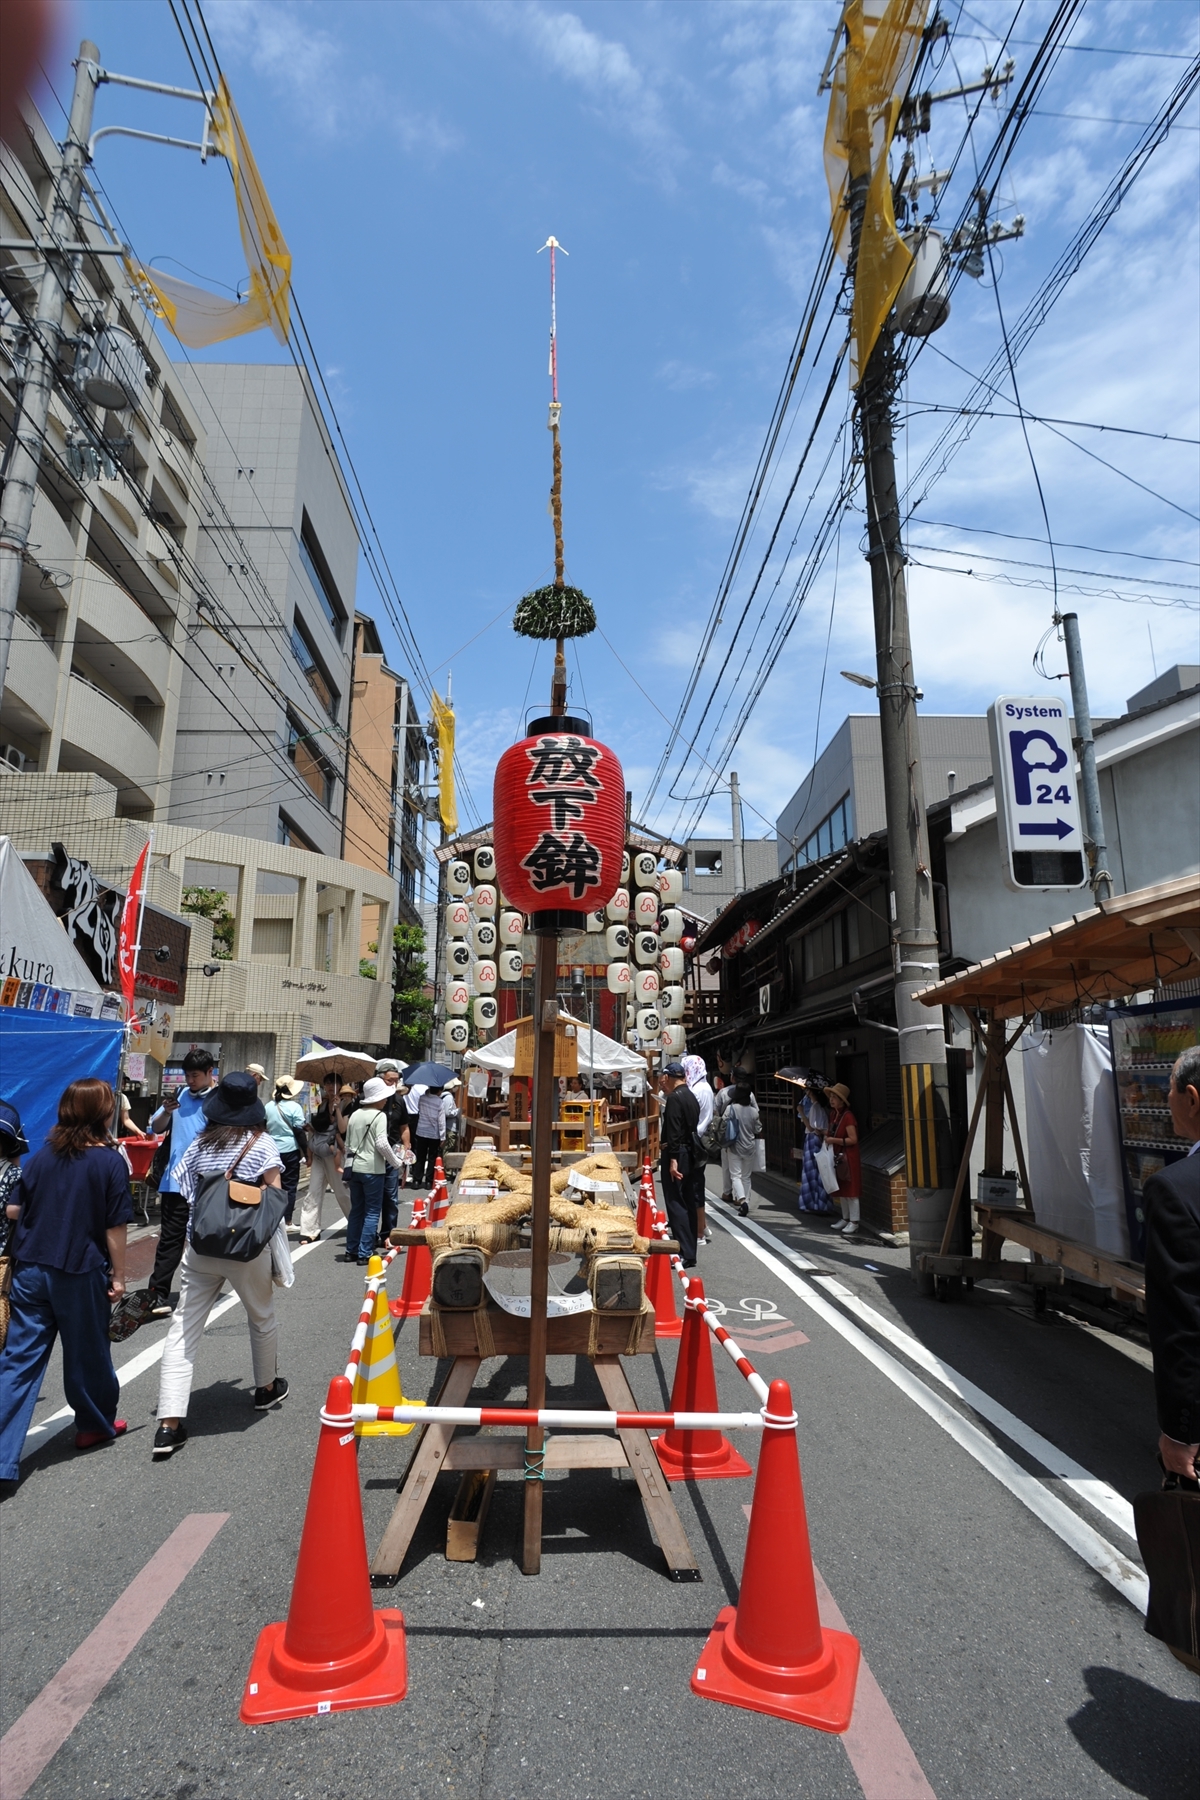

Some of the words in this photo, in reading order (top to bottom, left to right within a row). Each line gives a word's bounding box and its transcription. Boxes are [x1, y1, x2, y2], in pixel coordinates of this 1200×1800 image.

[1005, 704, 1062, 720] System
[1036, 784, 1071, 804] 24
[521, 737, 604, 899] 放下鉾
[514, 1305, 527, 1313] do
[557, 1303, 585, 1313] touch
